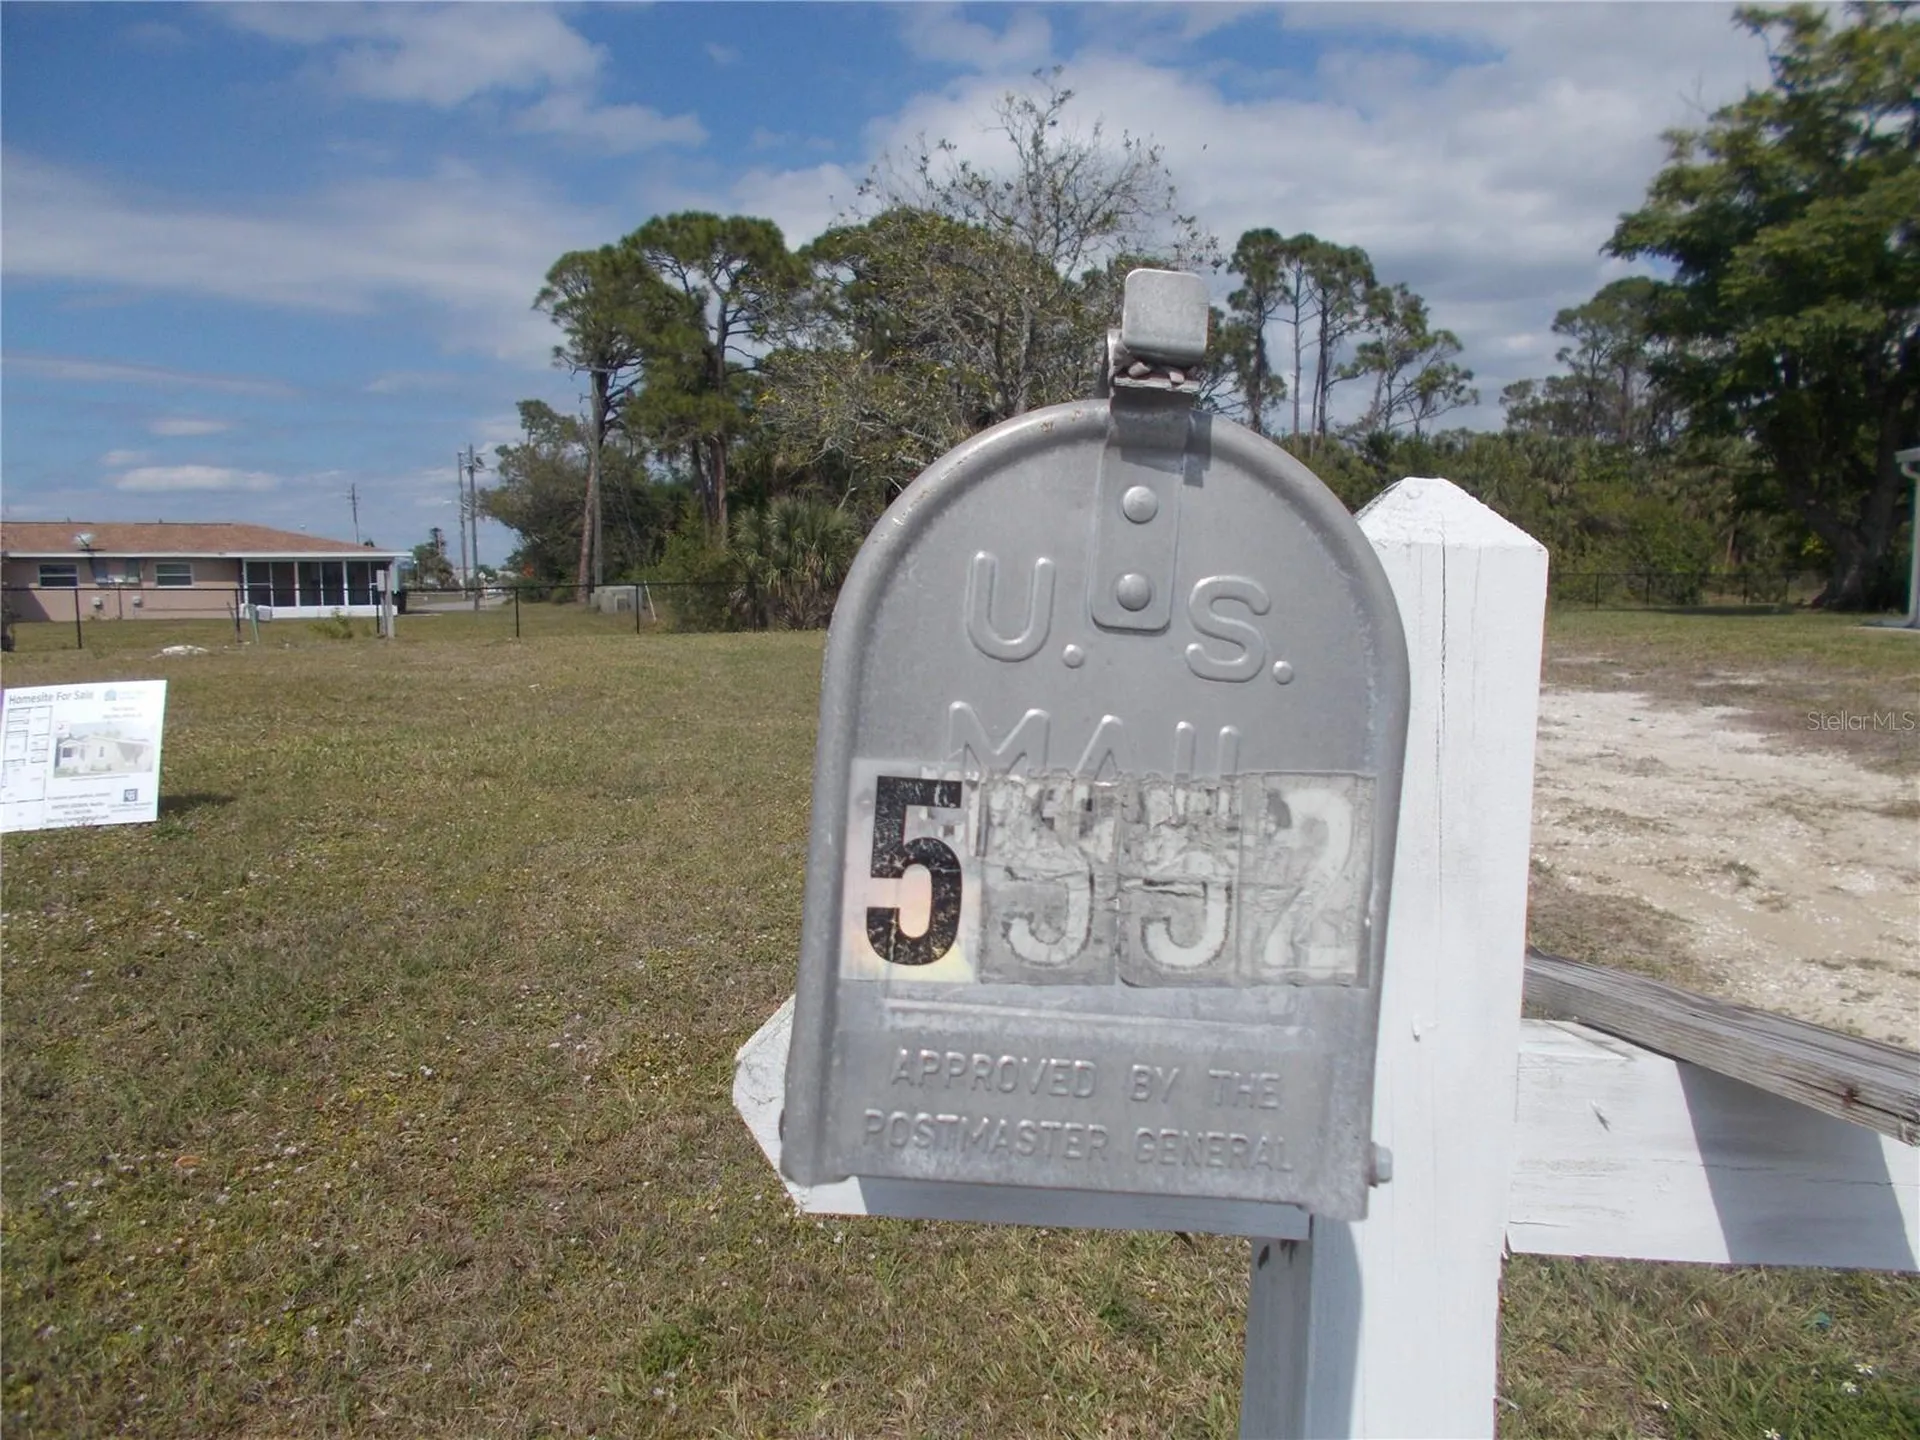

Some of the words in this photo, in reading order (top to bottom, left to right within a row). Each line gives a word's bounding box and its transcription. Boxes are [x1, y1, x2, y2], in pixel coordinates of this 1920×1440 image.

[8, 692, 54, 706] Homesite
[56, 690, 72, 702] For
[74, 689, 94, 701] Sale
[891, 1047, 1097, 1101] APPROVED
[1130, 1063, 1180, 1105] BY
[1208, 1068, 1282, 1110] THE
[862, 1107, 1109, 1163] POSTMASTER
[1133, 1127, 1295, 1173] GENERAL
